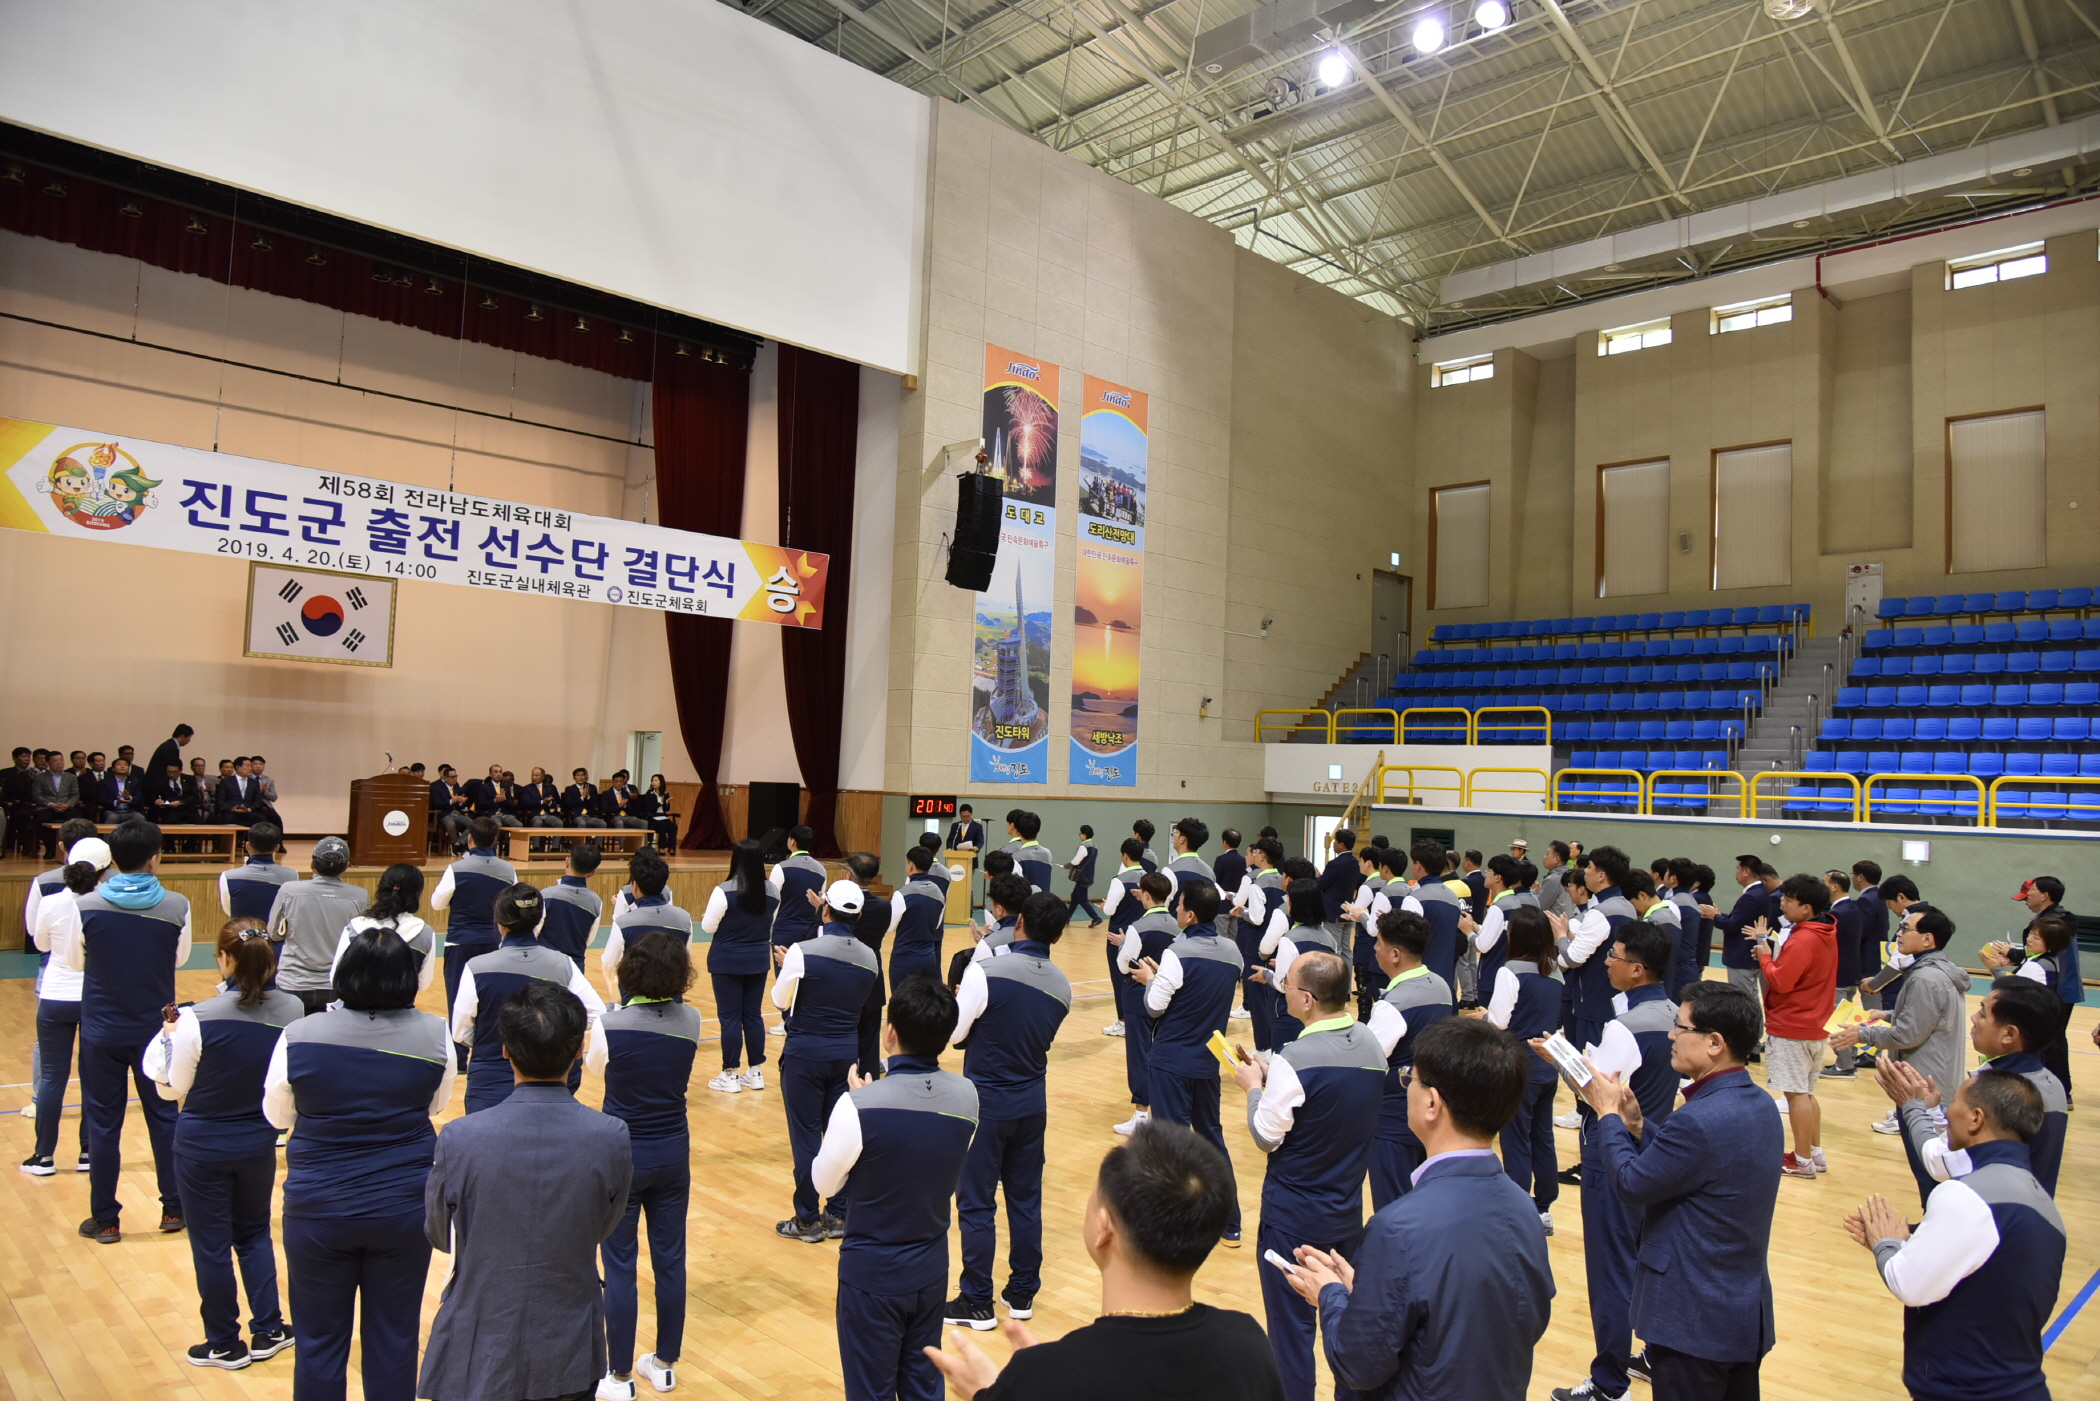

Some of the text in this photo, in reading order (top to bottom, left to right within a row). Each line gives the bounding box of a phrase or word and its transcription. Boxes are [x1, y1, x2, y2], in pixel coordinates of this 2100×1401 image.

[1005, 362, 1036, 380] Jindo
[1100, 391, 1127, 407] Jindo
[318, 475, 573, 532] 제58회 전라남도체육대회
[1005, 504, 1045, 525] 도대교
[179, 478, 736, 599] 진도군 출전 선수단 결단식
[1088, 521, 1136, 546] 도리산전망대
[217, 537, 437, 579] 2019. 4. 20.(토) 14:00
[467, 569, 591, 599] 진도군실내체육관
[765, 565, 800, 614] 승
[627, 591, 708, 613] 진도군체육회
[995, 724, 1031, 740] 진도타워
[1091, 730, 1123, 745] 세방낙조
[1313, 781, 1350, 793] GATE
